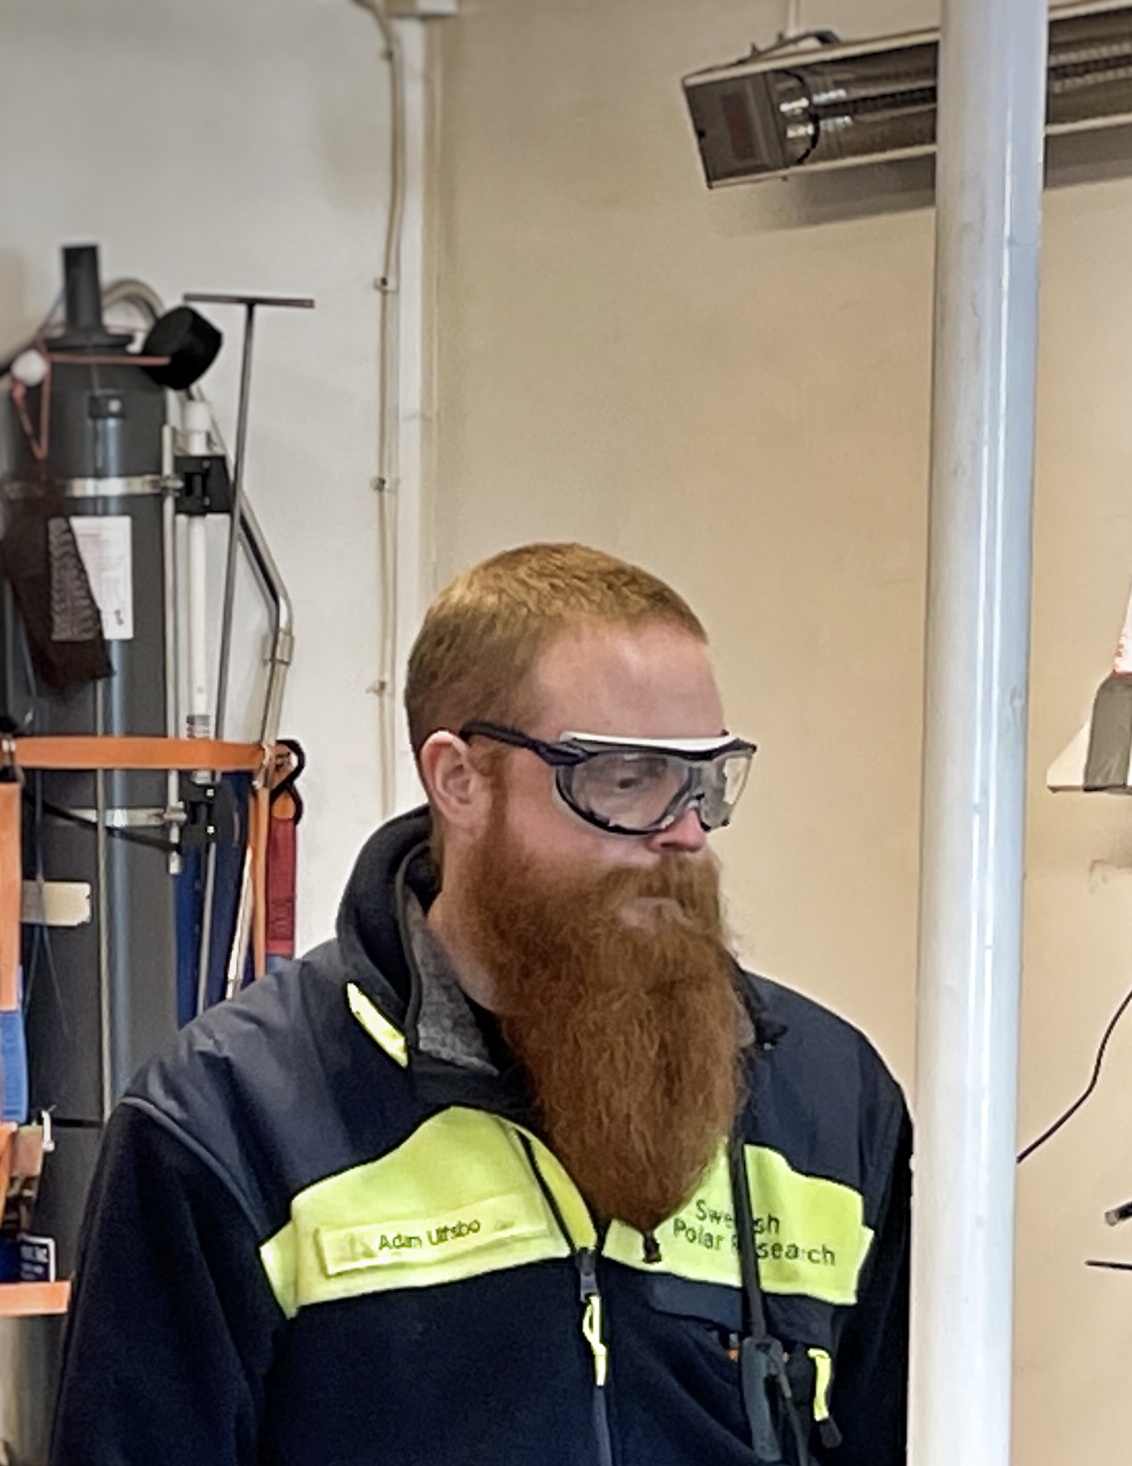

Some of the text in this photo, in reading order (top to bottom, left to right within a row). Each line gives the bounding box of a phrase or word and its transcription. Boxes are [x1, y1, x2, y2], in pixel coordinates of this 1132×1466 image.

[695, 1199, 780, 1236] Swesh
[673, 1217, 836, 1267] Polar search
